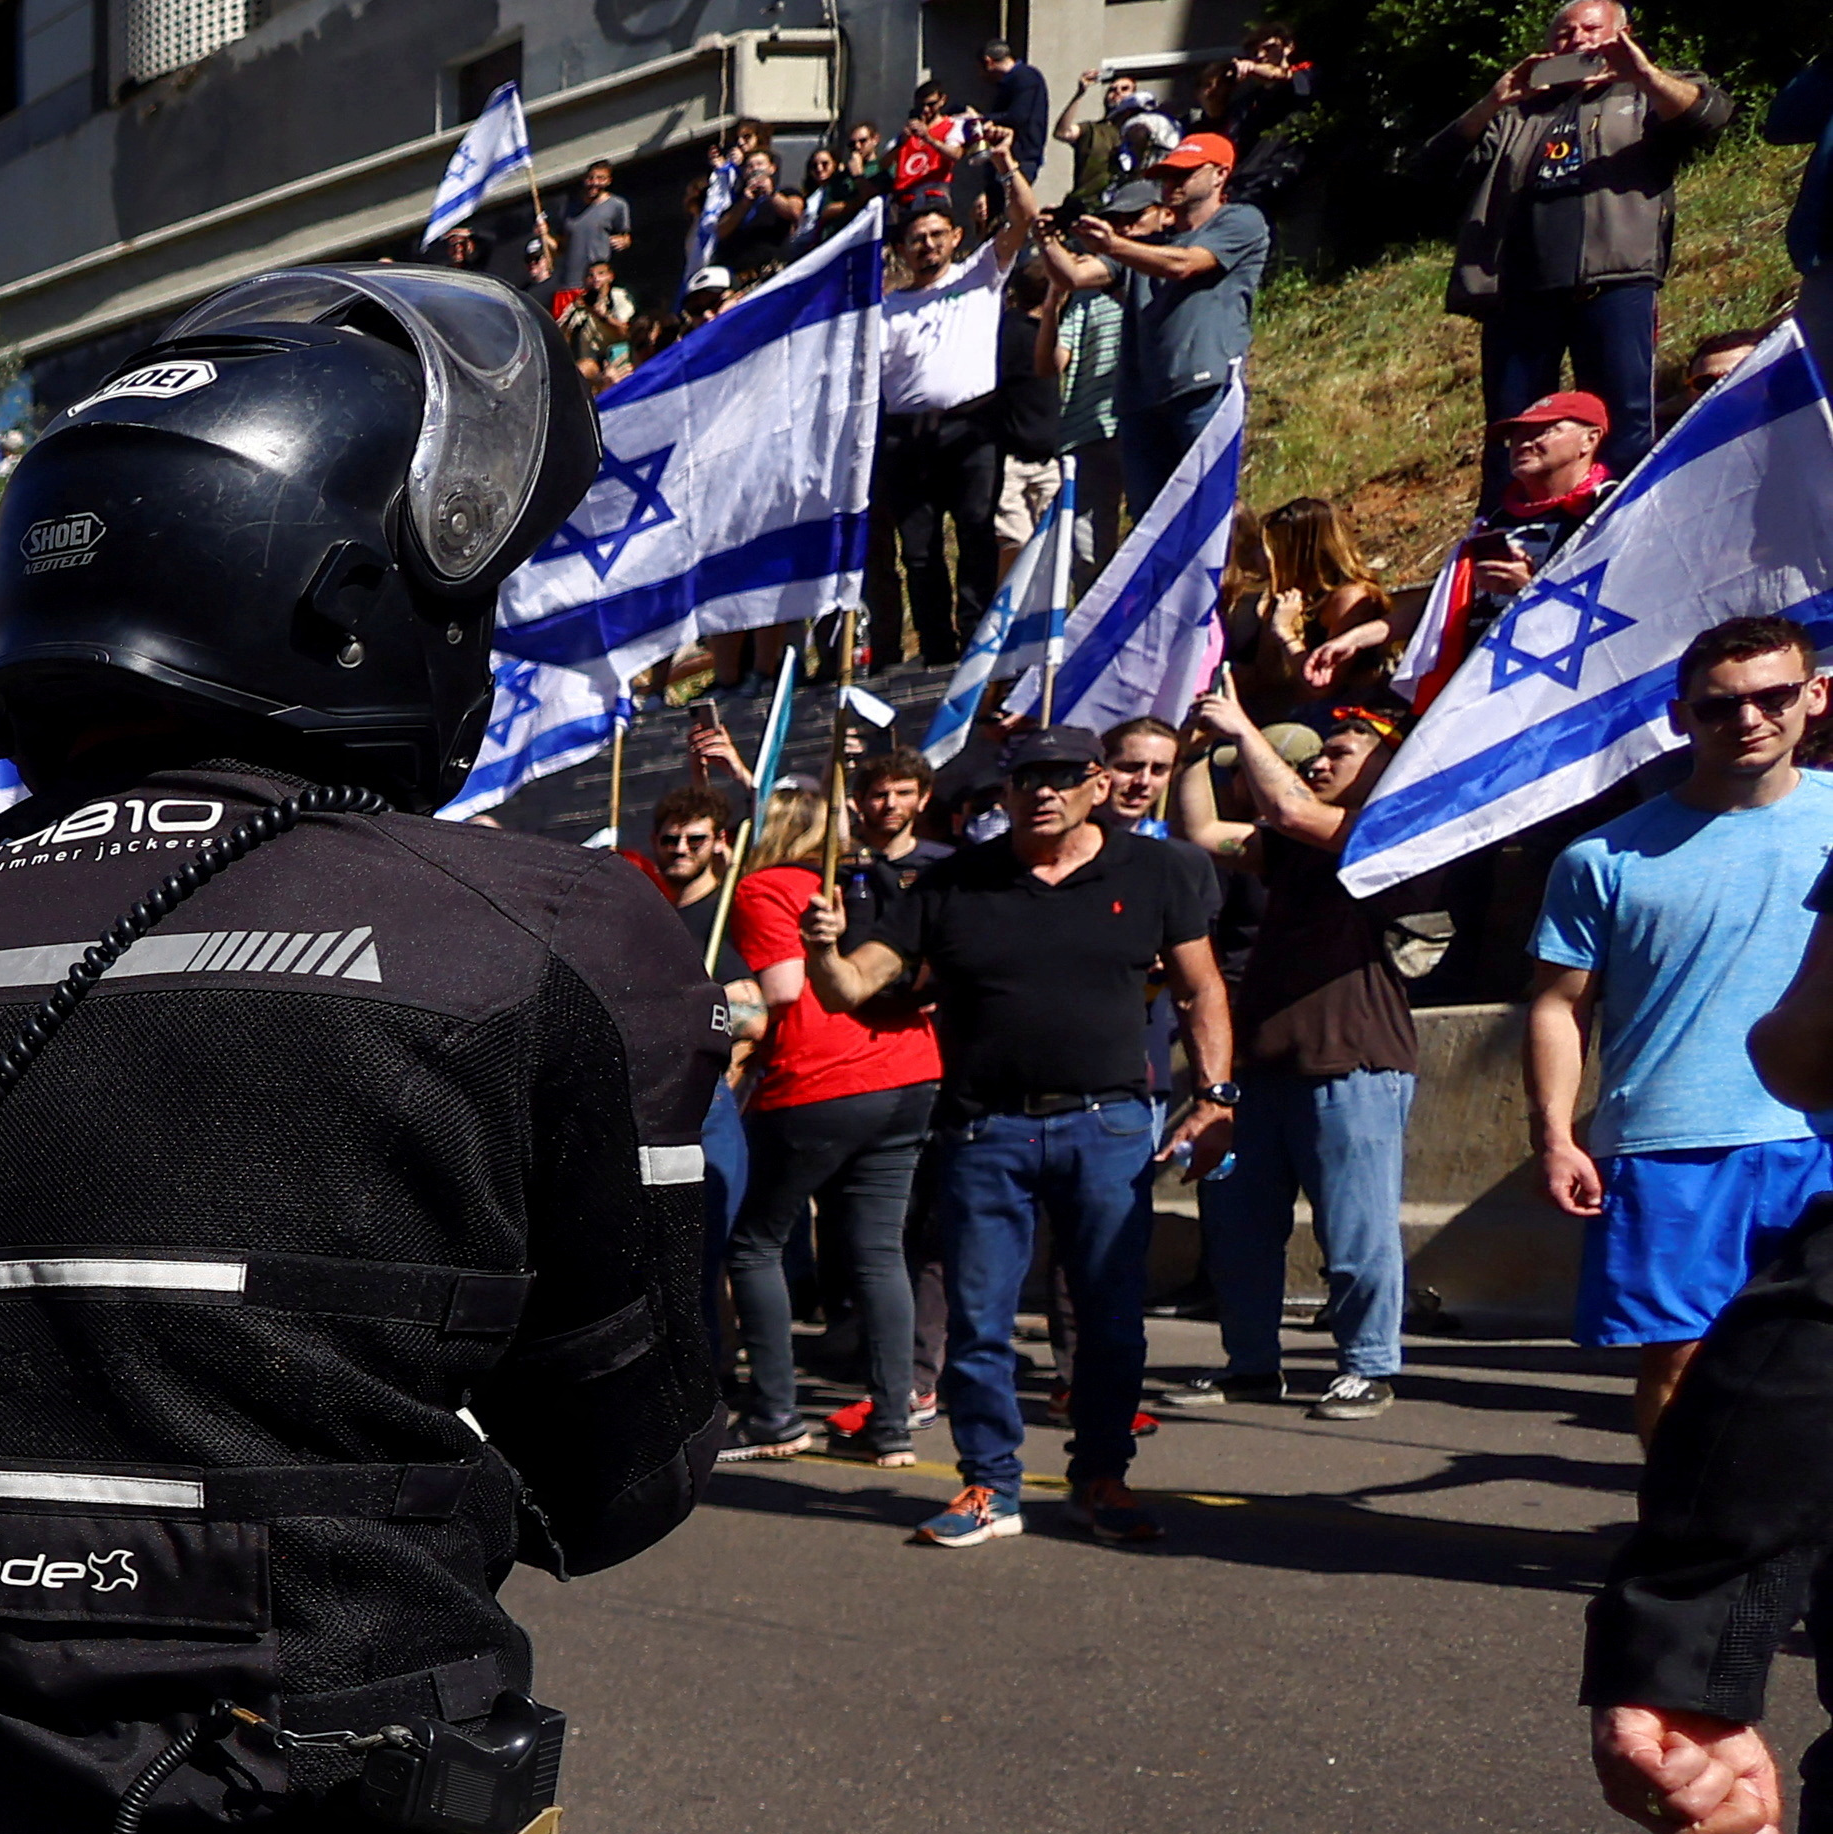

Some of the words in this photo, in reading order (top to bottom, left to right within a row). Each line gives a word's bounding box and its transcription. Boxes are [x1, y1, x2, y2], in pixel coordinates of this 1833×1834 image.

[100, 367, 198, 396] HOEI
[30, 519, 92, 554] SHOEI
[95, 836, 214, 862] jackets
